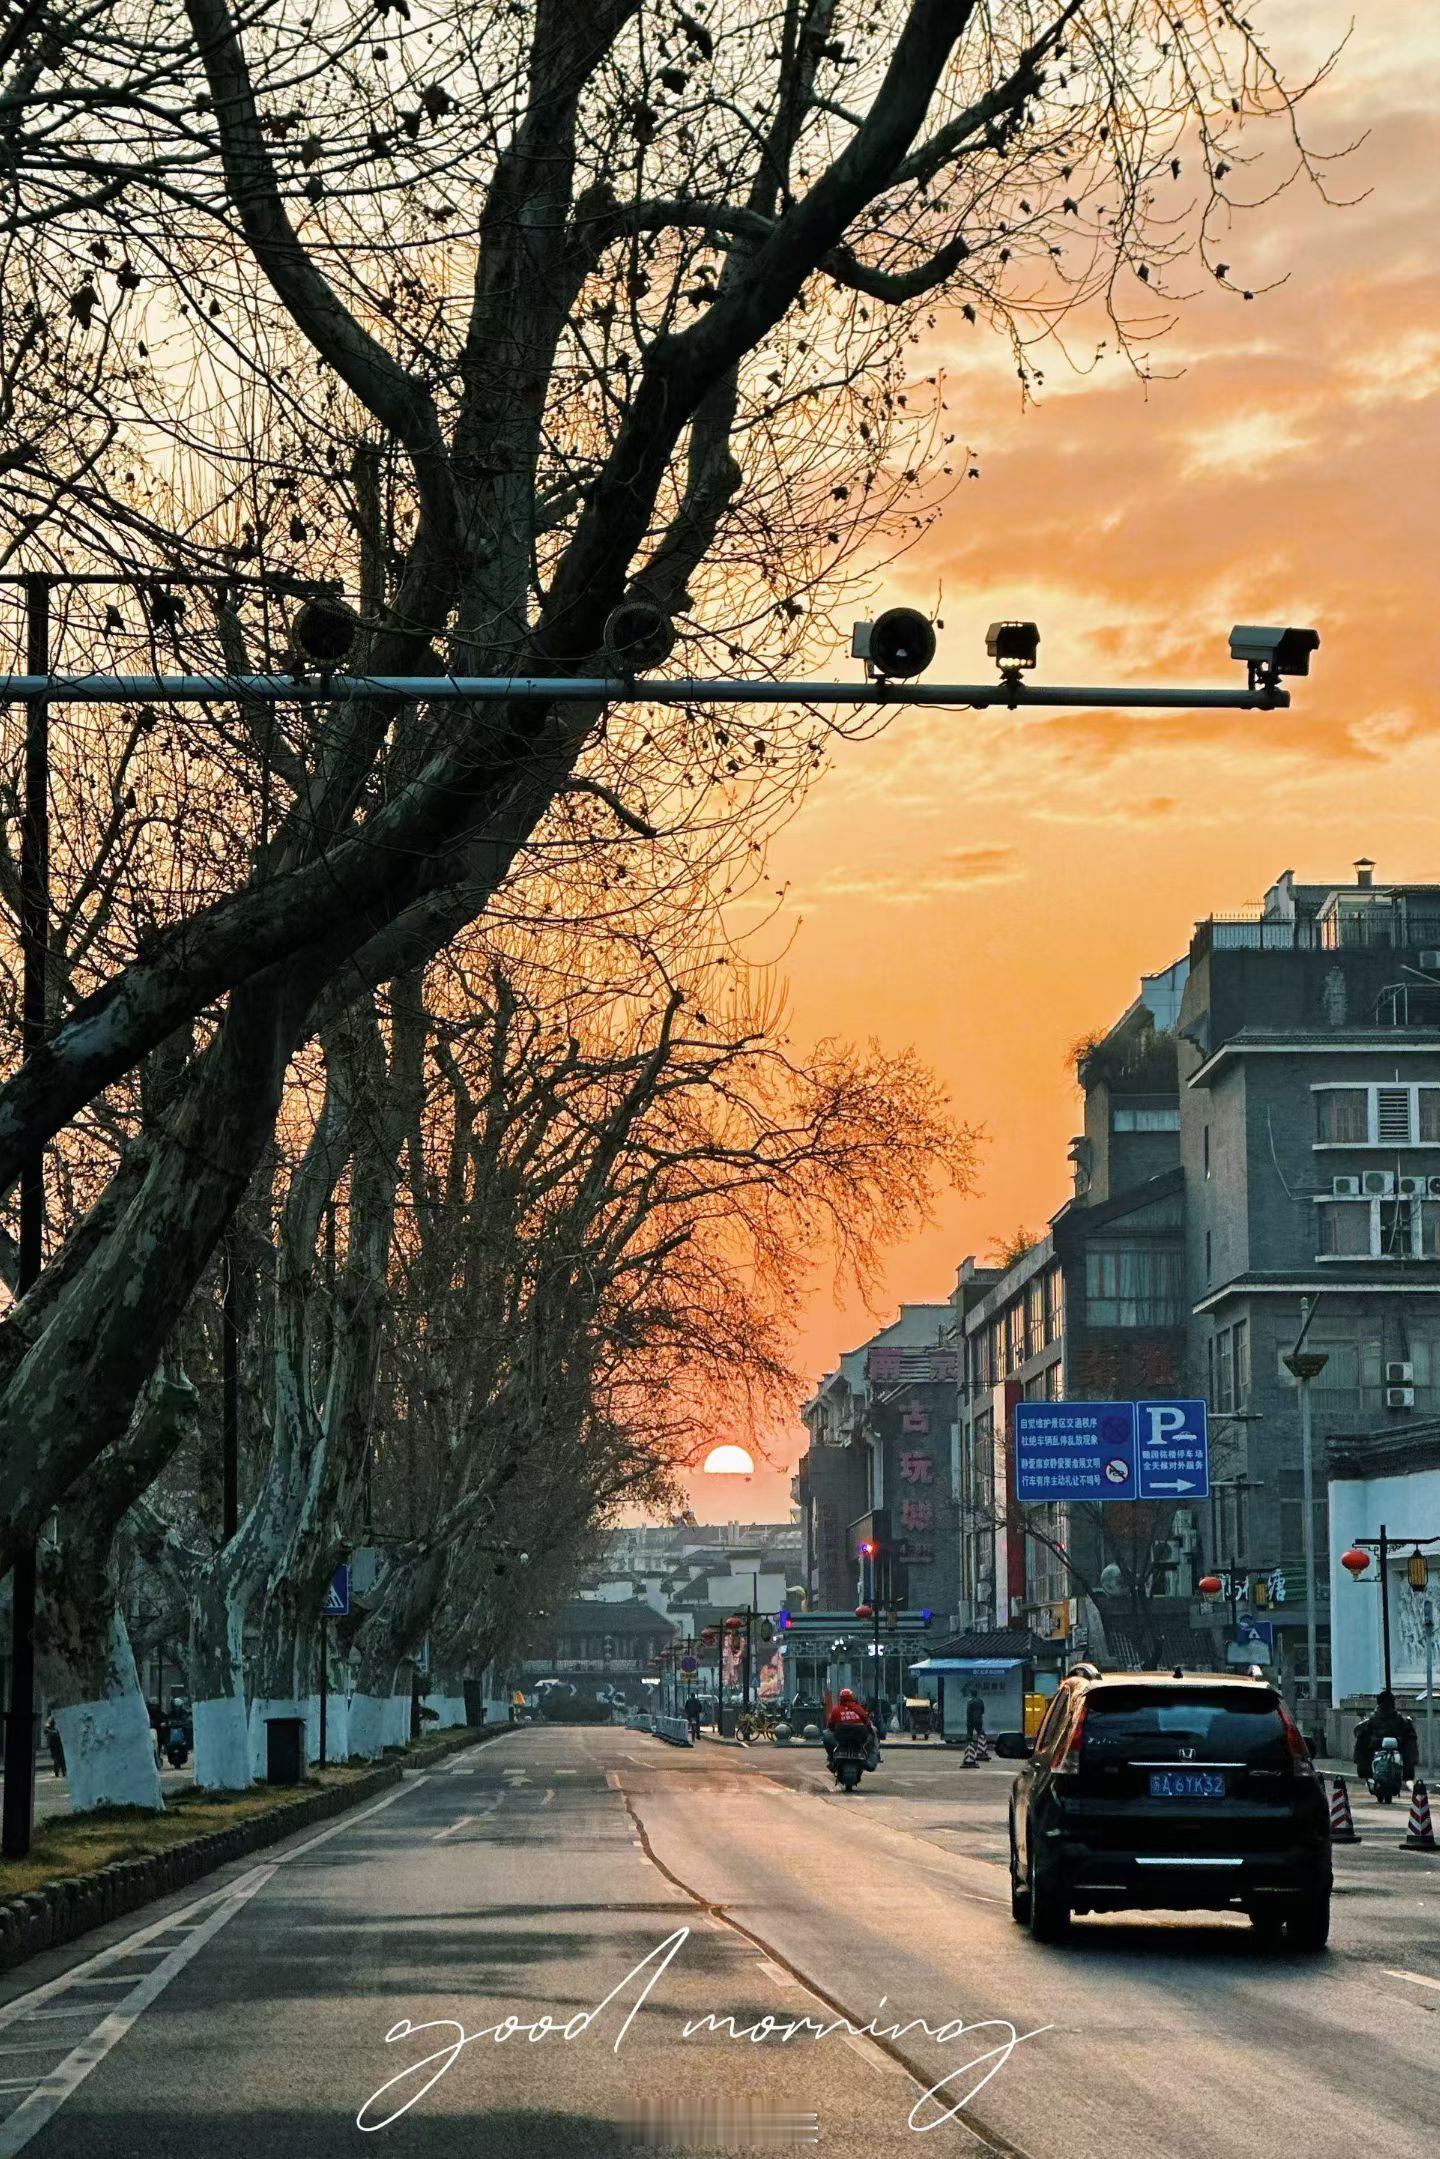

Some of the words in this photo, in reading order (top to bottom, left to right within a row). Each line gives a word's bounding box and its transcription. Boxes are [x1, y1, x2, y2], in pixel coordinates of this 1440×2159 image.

[1020, 1417, 1098, 1429] 自觉维护景区交通秩序
[1146, 1407, 1185, 1445] P
[1021, 1434, 1099, 1446] 杜绝车辆乱停乱放现象
[1022, 1475, 1102, 1487] 行车有序主动礼让不鸣号
